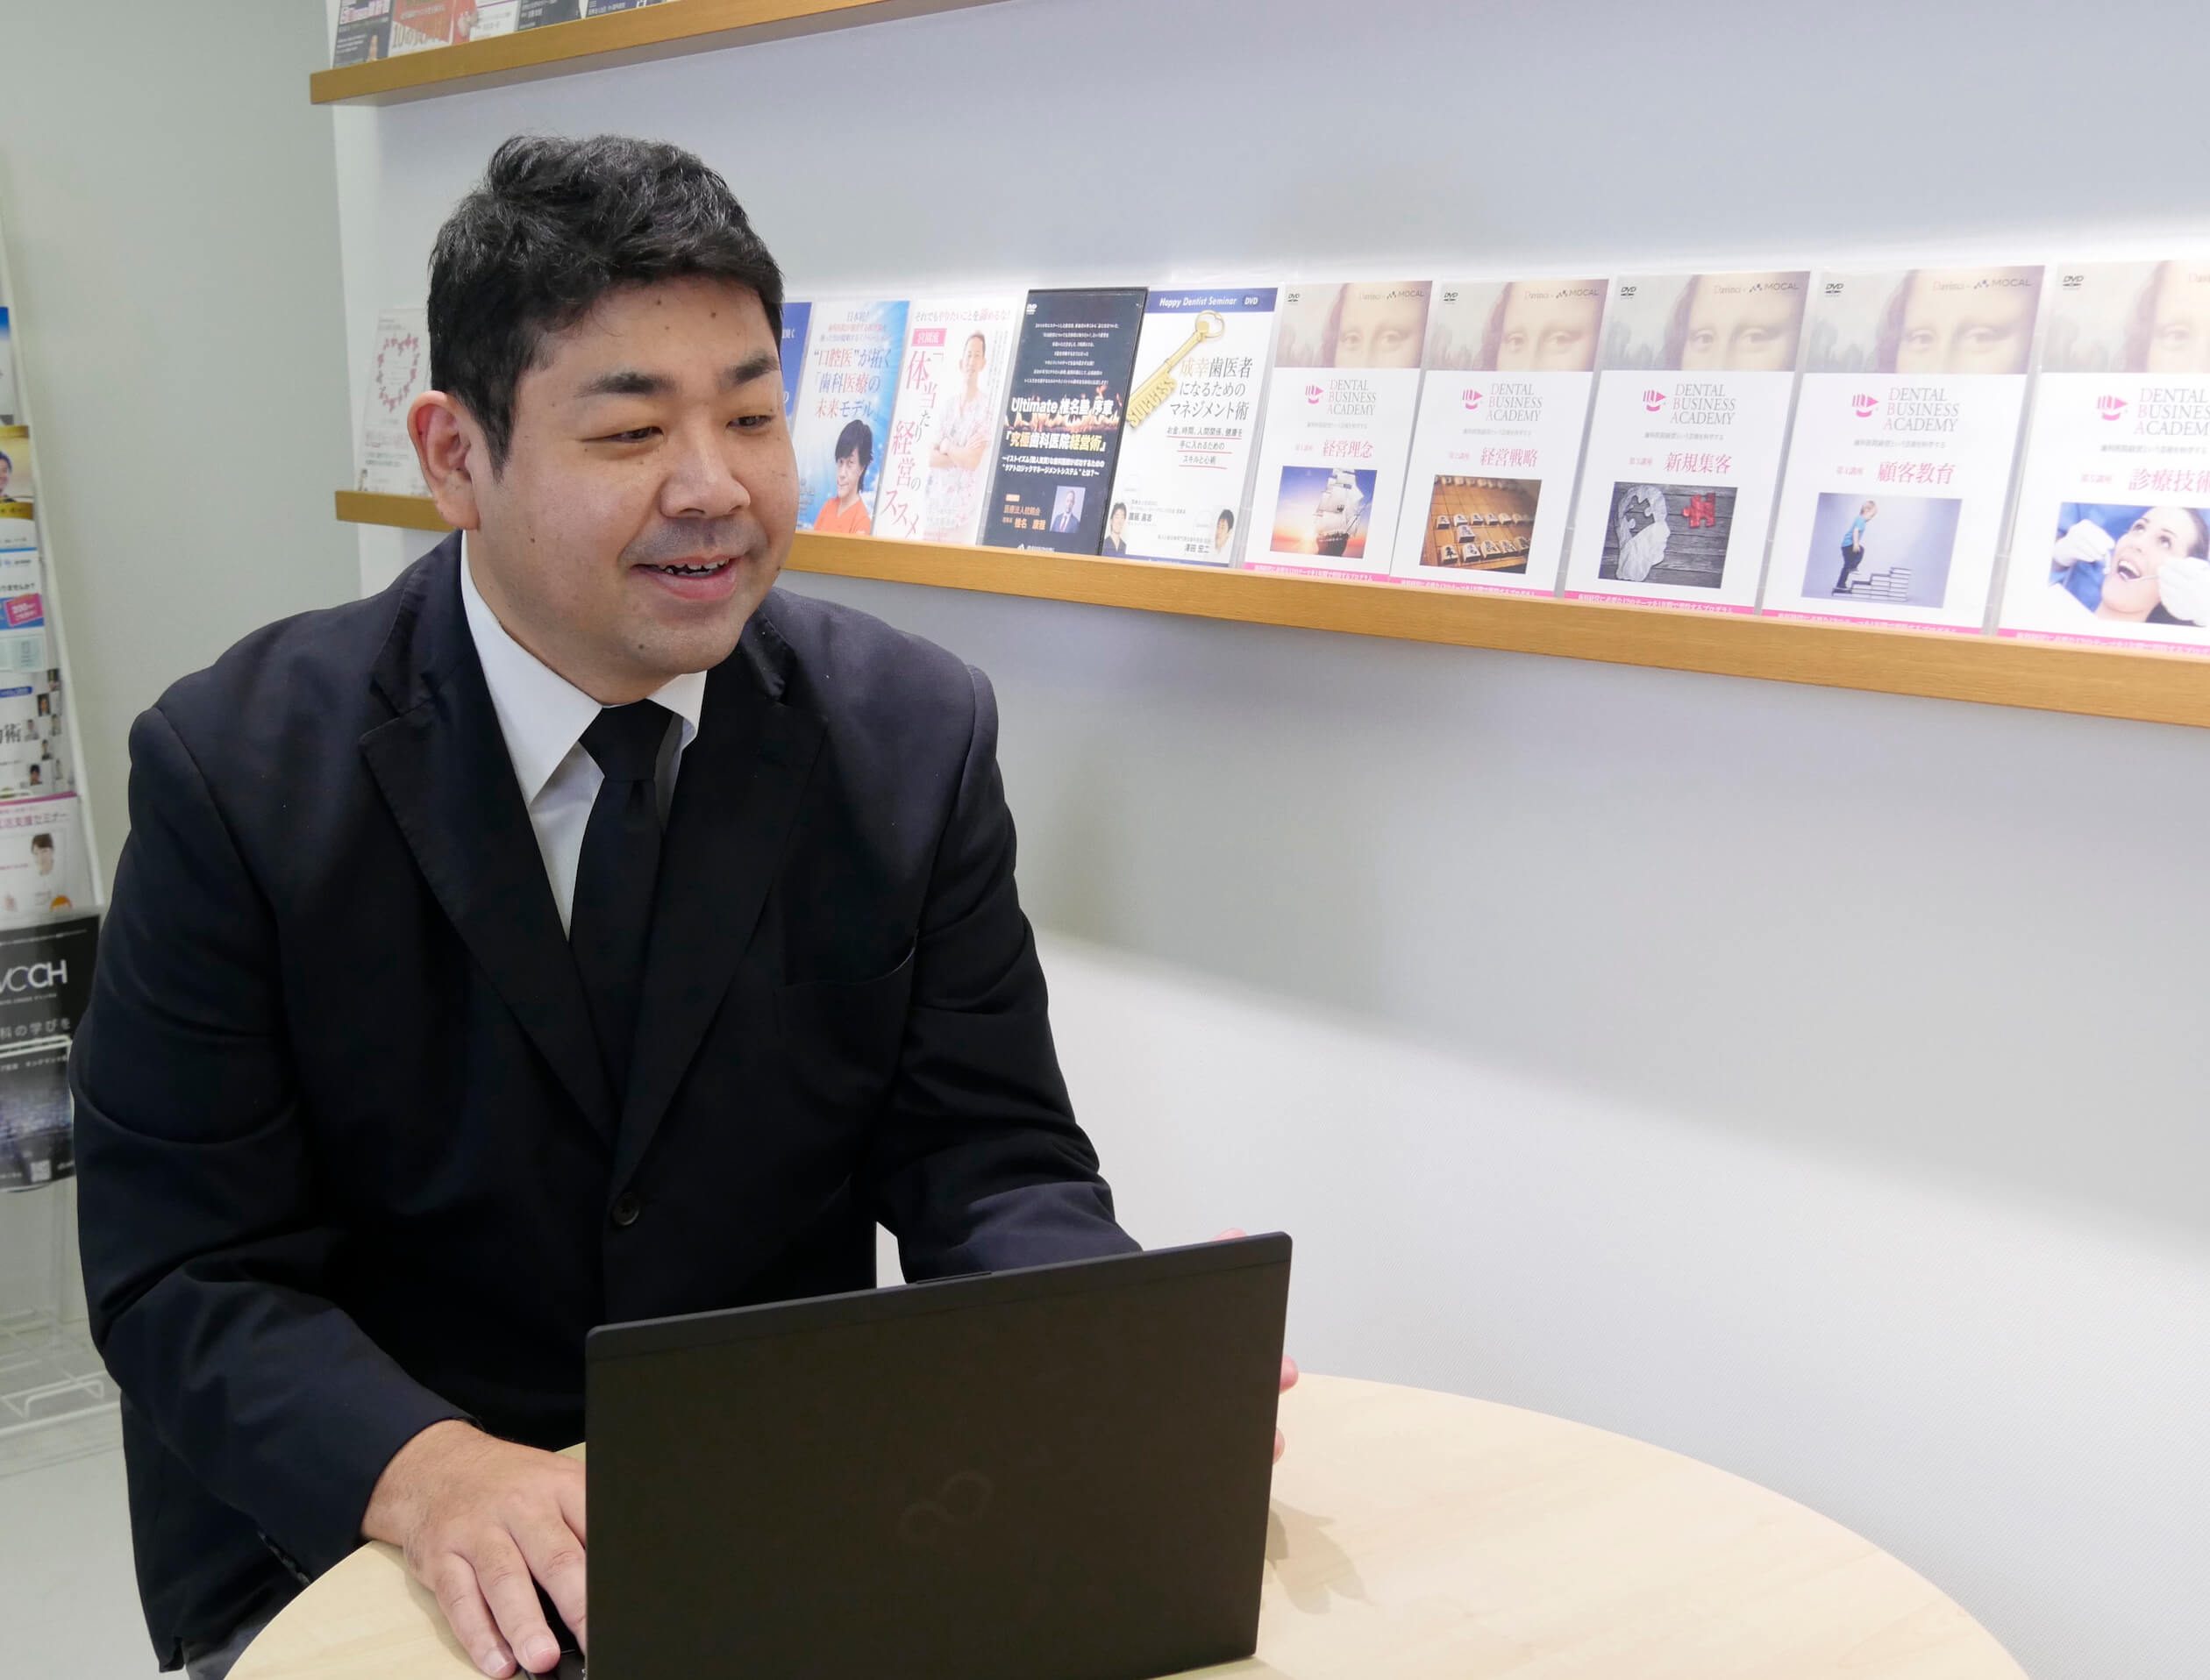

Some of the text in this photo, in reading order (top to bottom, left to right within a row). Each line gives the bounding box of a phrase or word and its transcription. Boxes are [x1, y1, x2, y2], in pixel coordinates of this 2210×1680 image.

[1159, 296, 1259, 308] Happy Dentist Seminar DVD
[1180, 357, 1252, 379] 成幸歯医者
[1180, 381, 1246, 397] になるための
[1330, 379, 1369, 391] DENTAL
[1490, 383, 1534, 395] DENTAL
[1676, 383, 1725, 397] DENTAL
[1328, 391, 1377, 403] BUSINESS
[1889, 388, 1948, 402] DENTAL
[2140, 388, 2208, 403] DENTAL
[1011, 397, 1058, 415] Ultimate
[1327, 403, 1376, 416] ACADEMY
[1488, 396, 1543, 409] BUSINESS
[1673, 398, 1736, 411] BUSINESS
[1886, 402, 1960, 417] BUSINESS
[1170, 400, 1250, 421] マネジメント術
[1486, 409, 1542, 422] ACADEMY
[1670, 411, 1736, 425] ACADEMY
[1883, 417, 1958, 432] ACADEMY
[1322, 439, 1373, 459] 経営理念
[1480, 447, 1538, 468] 経営戦略
[1665, 452, 1732, 475] 新規集客
[1877, 461, 1956, 485] 顧客教育
